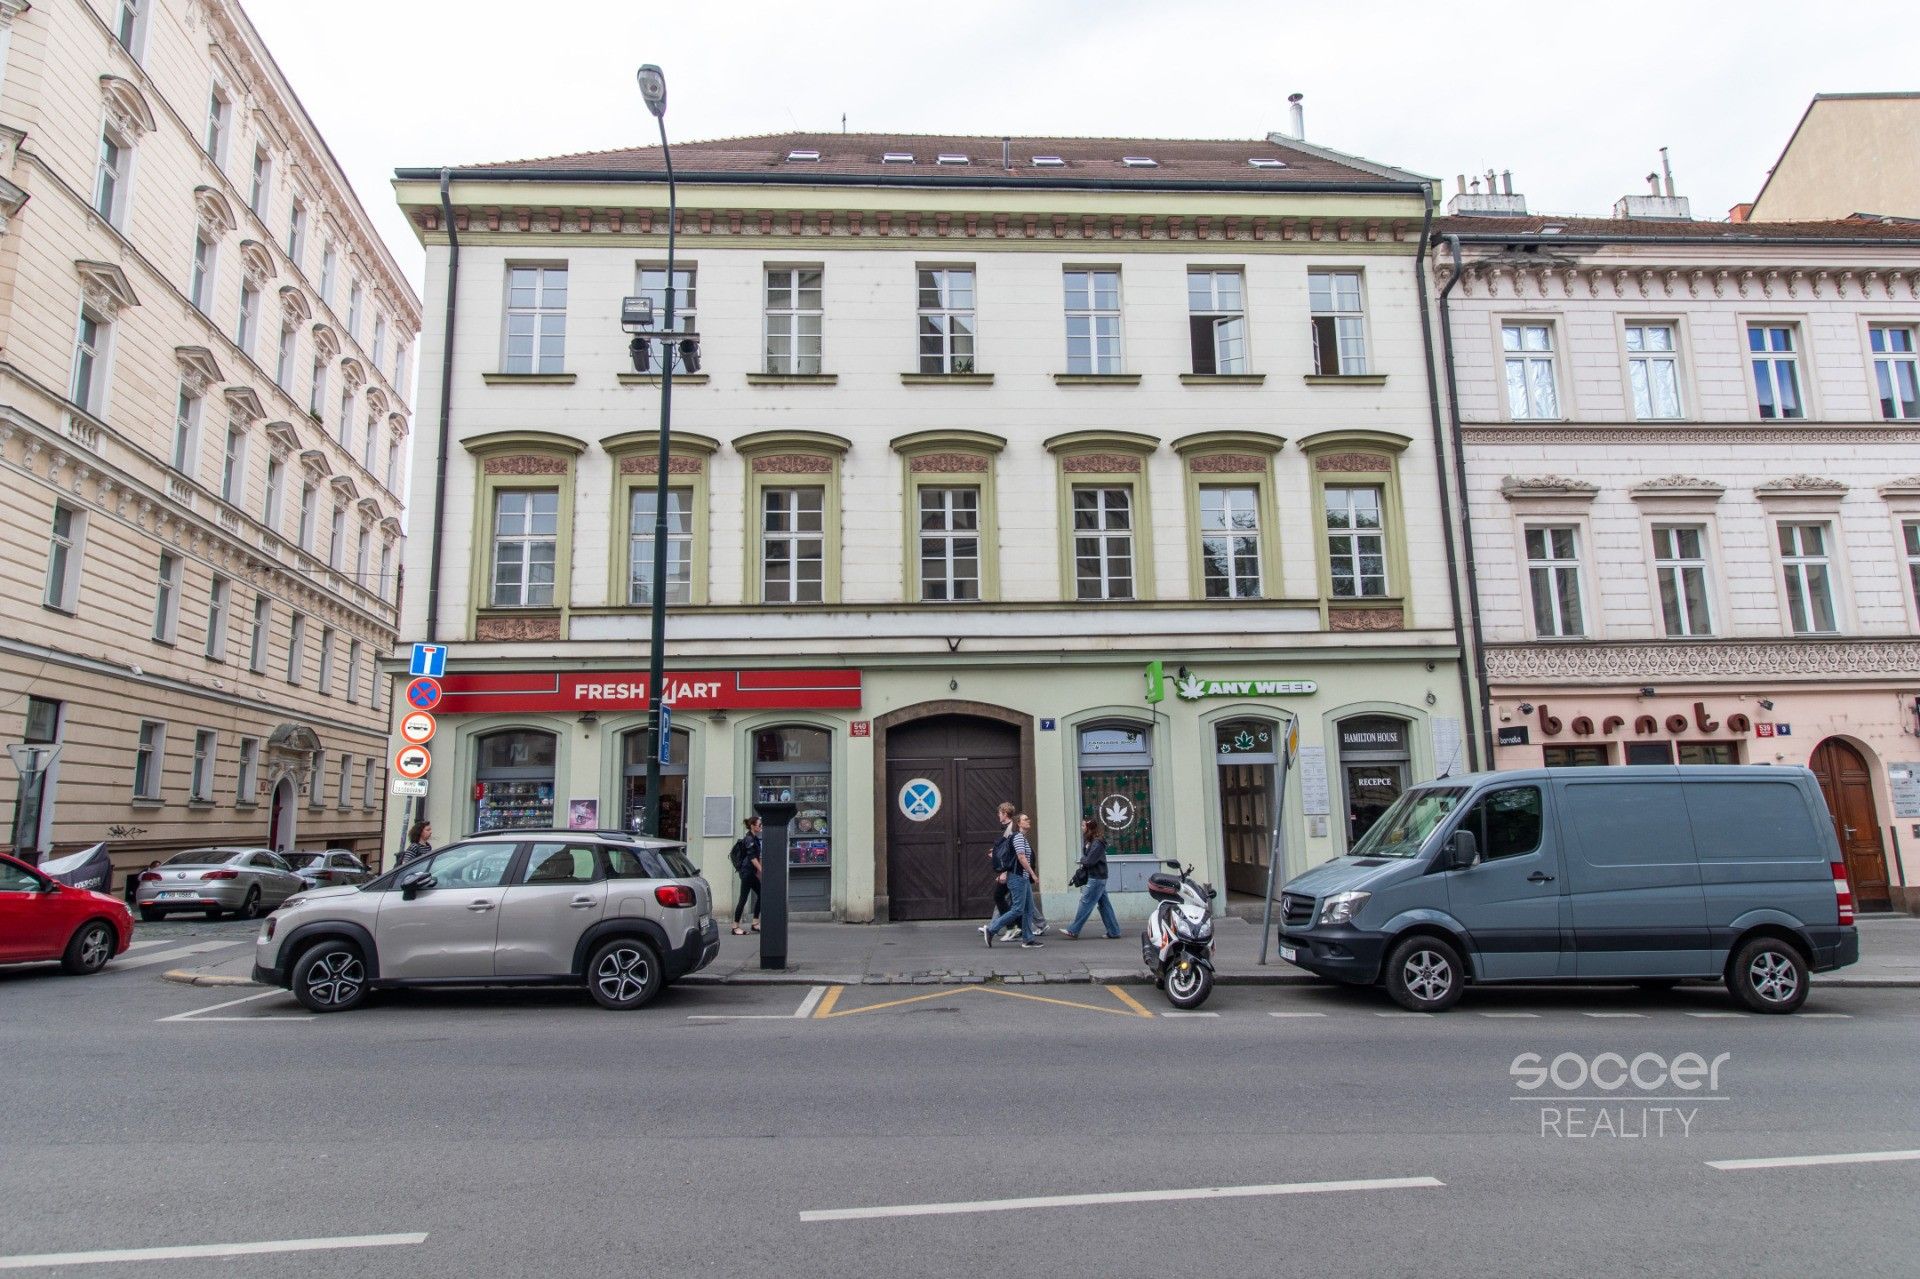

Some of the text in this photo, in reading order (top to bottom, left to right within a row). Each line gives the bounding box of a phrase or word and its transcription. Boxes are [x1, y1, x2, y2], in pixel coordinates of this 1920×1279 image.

[575, 683, 645, 699] FRESH
[1207, 681, 1318, 694] ANY WEED
[1538, 702, 1751, 735] barnota
[854, 722, 867, 730] 540
[1344, 732, 1398, 743] HAMILTON HOUSE
[1358, 778, 1391, 786] RECEPCE
